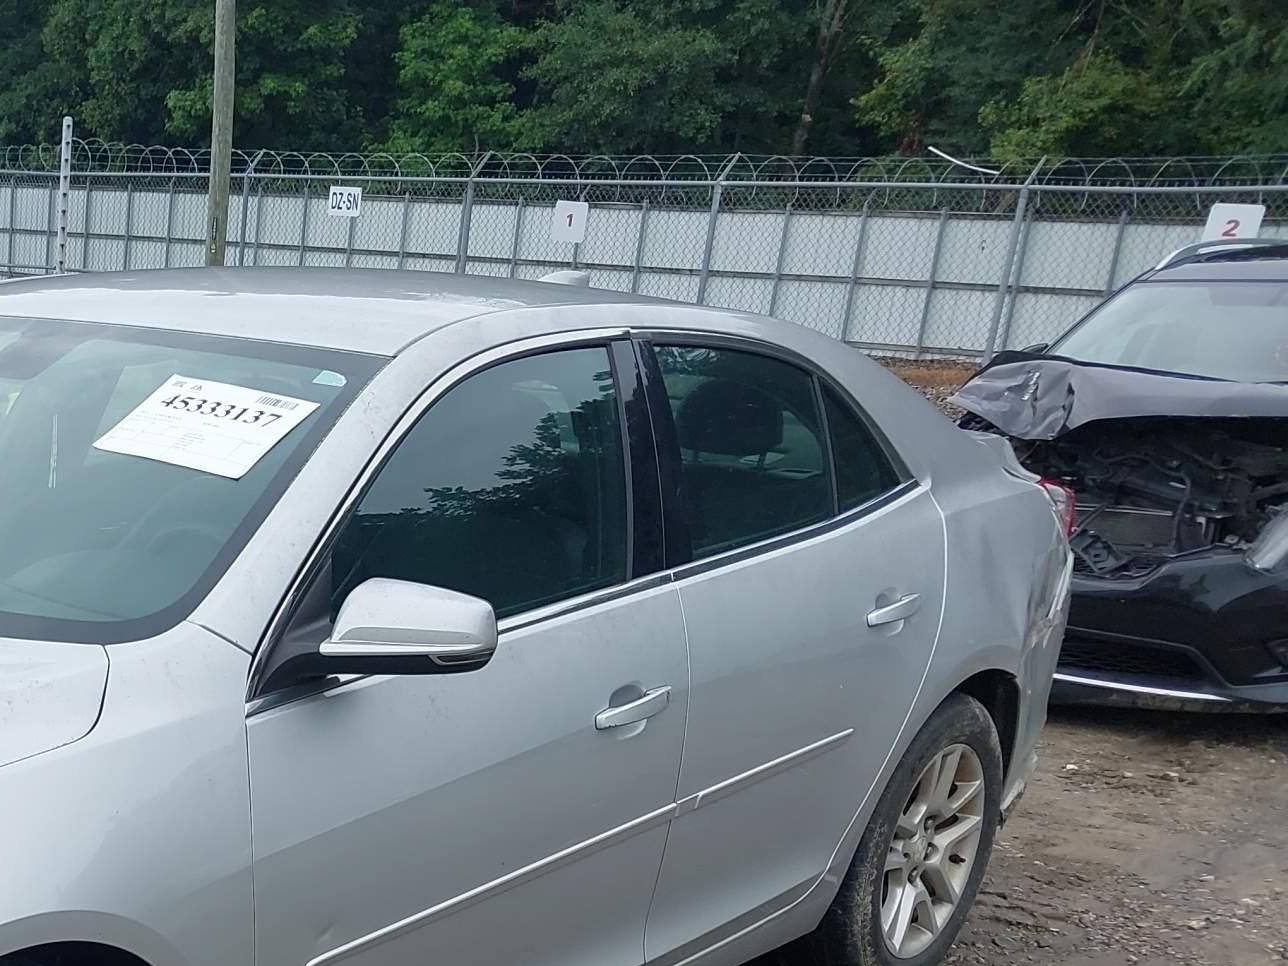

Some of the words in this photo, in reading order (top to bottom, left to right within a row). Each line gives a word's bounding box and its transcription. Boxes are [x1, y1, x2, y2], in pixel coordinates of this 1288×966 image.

[566, 213, 575, 228] 1
[1221, 219, 1241, 237] 2
[160, 393, 284, 428] 45333137
